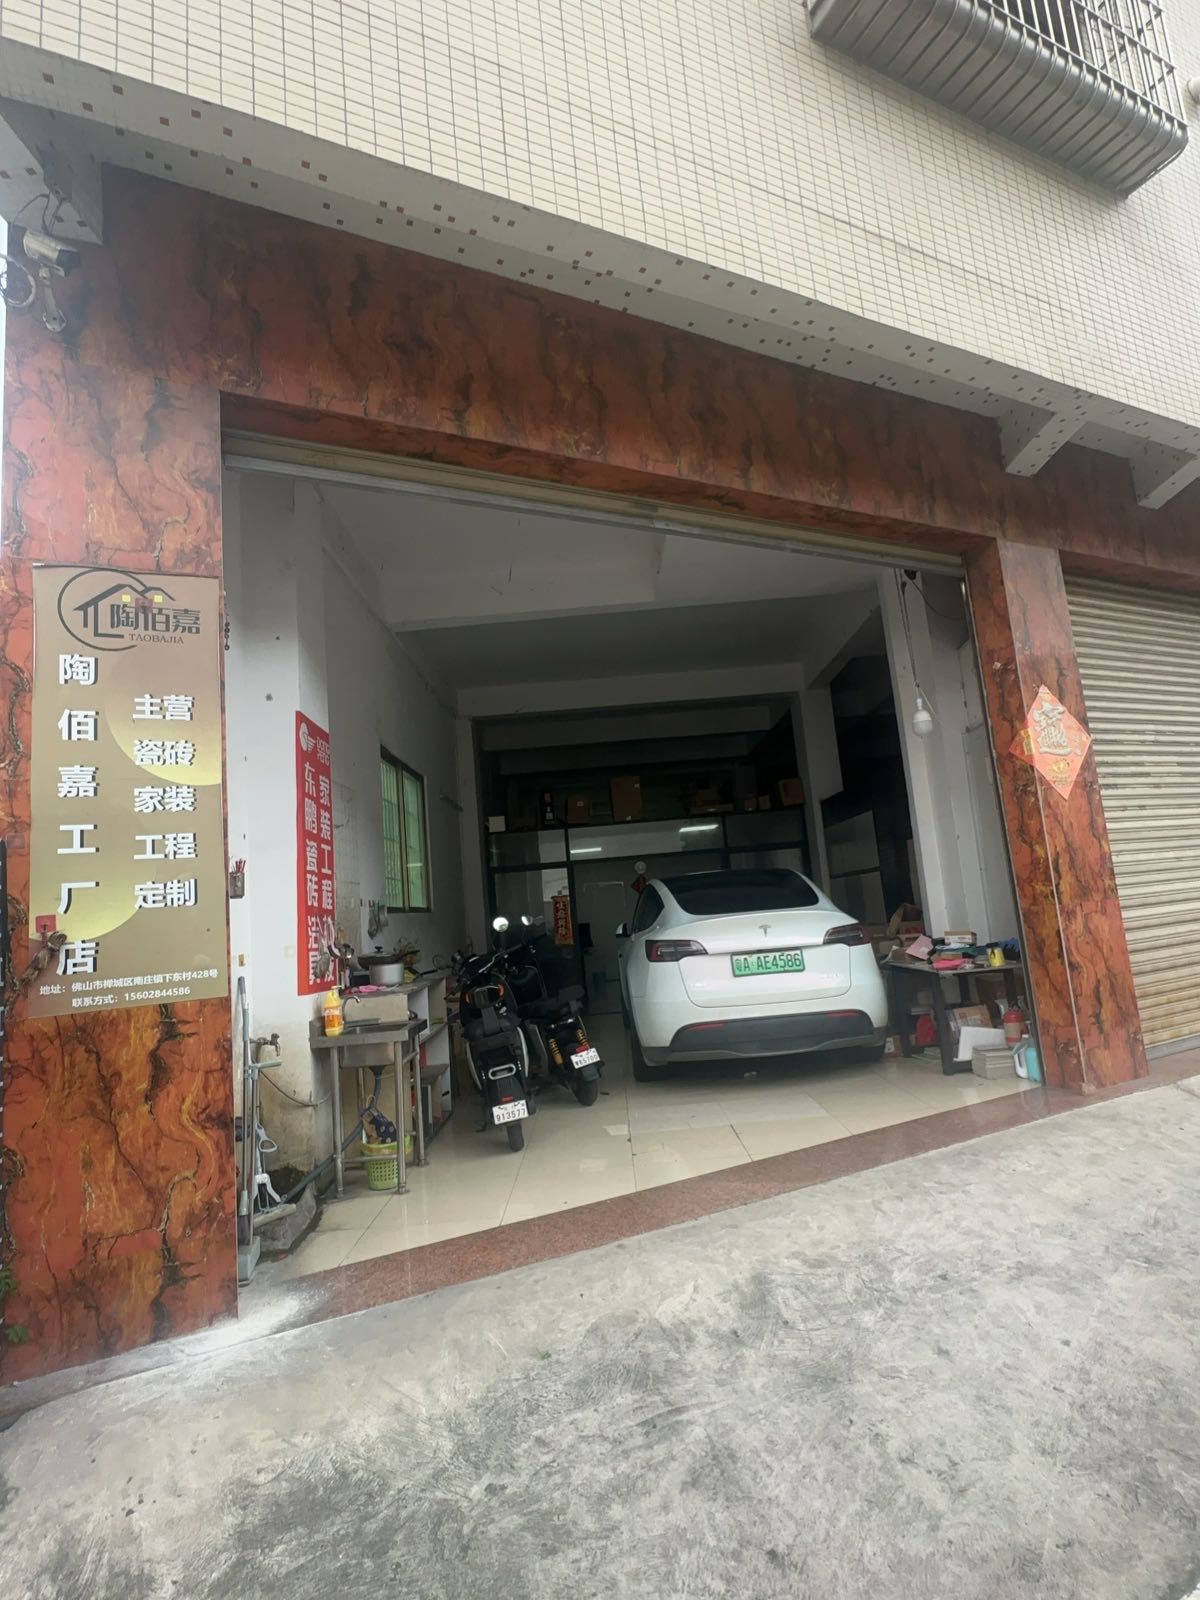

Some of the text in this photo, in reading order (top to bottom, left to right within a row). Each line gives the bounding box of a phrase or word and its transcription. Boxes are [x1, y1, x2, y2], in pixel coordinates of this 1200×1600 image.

[110, 603, 201, 635] 陶佰嘉
[128, 633, 185, 645] TAOBAJIA
[132, 693, 195, 722] 主营
[134, 739, 196, 766] 瓷砖
[133, 785, 197, 813] 家装
[133, 832, 198, 860] 工程
[133, 878, 198, 909] 定制
[495, 1107, 527, 1122] 913577
